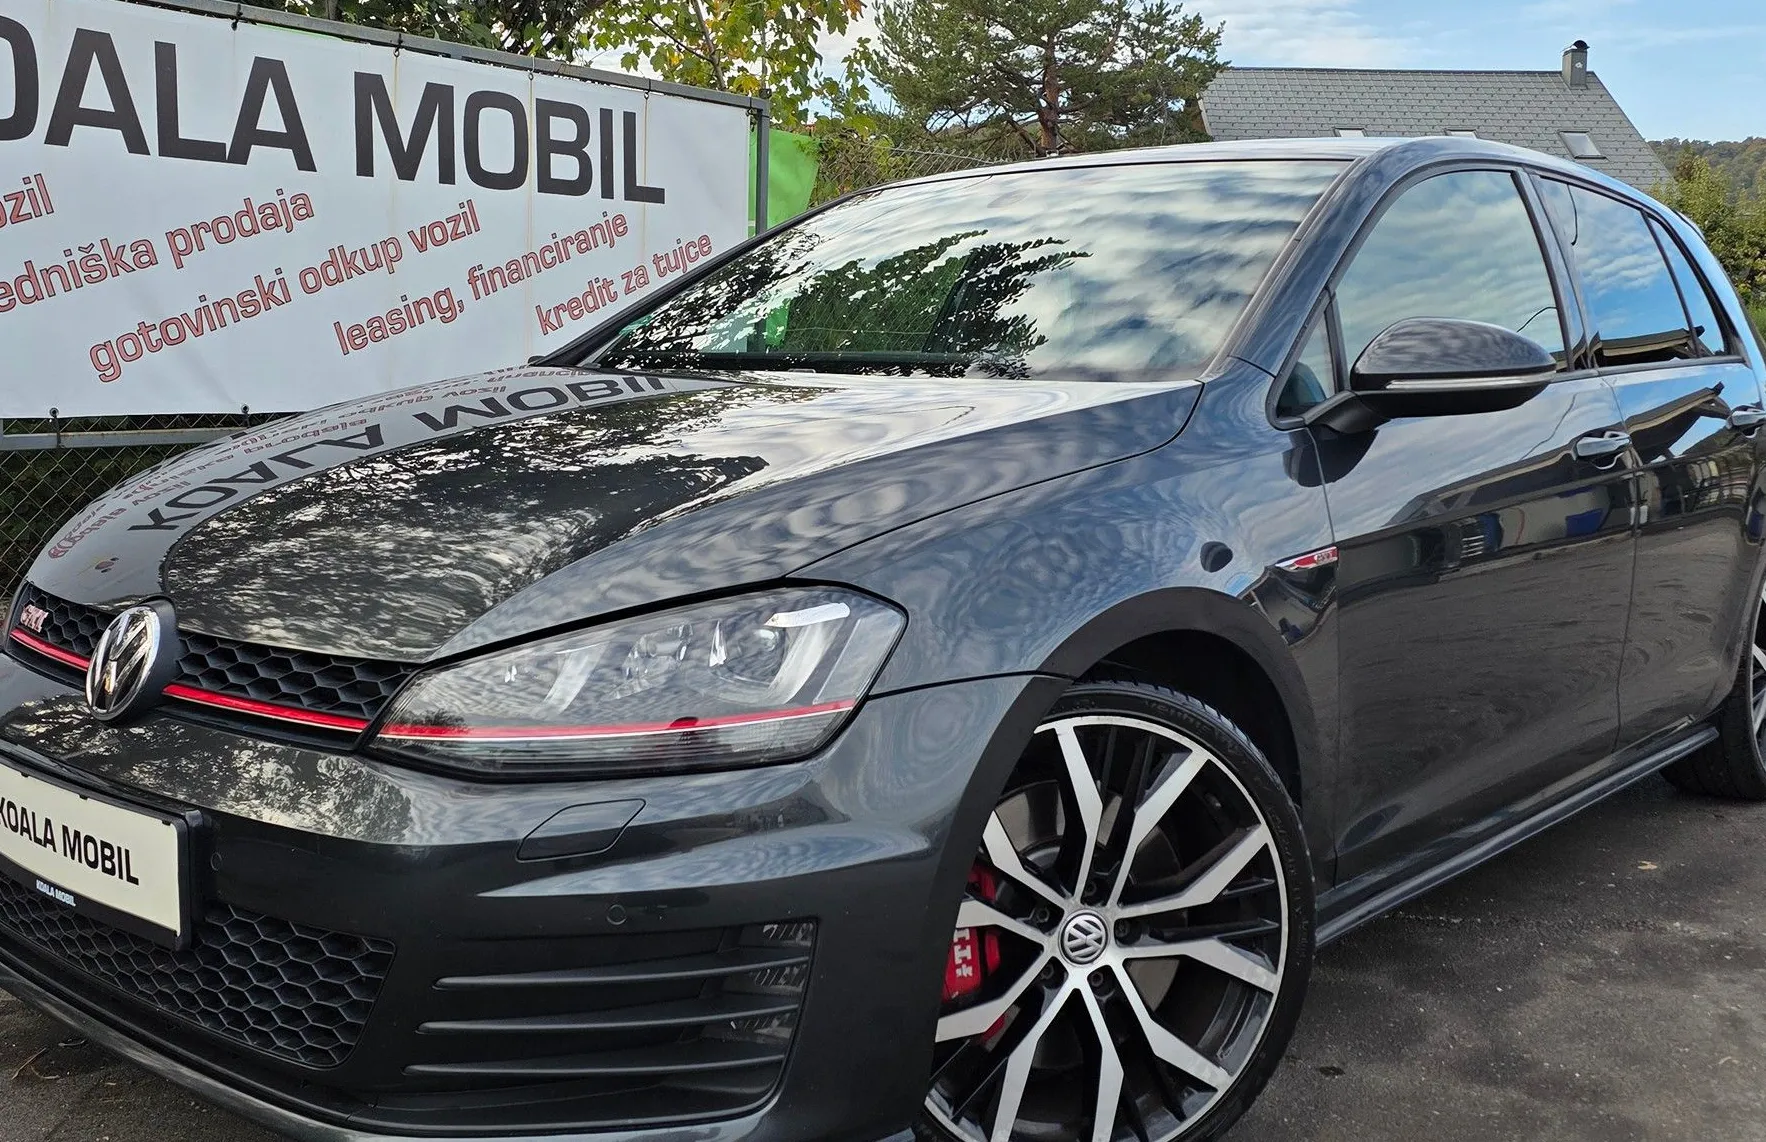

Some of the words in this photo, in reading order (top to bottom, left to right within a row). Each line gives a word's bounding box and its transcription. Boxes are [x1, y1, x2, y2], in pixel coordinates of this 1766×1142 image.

[353, 71, 665, 204] MOBIL
[165, 188, 314, 269] prodaja
[333, 287, 464, 356] leasing,
[467, 211, 628, 301] financiranje
[535, 276, 618, 336] kredit
[620, 264, 649, 296] za
[652, 234, 713, 279] tujce
[89, 268, 292, 383] gotovinski
[298, 236, 403, 295] odkup
[407, 199, 481, 255] vozil
[62, 824, 140, 886] MOBIL
